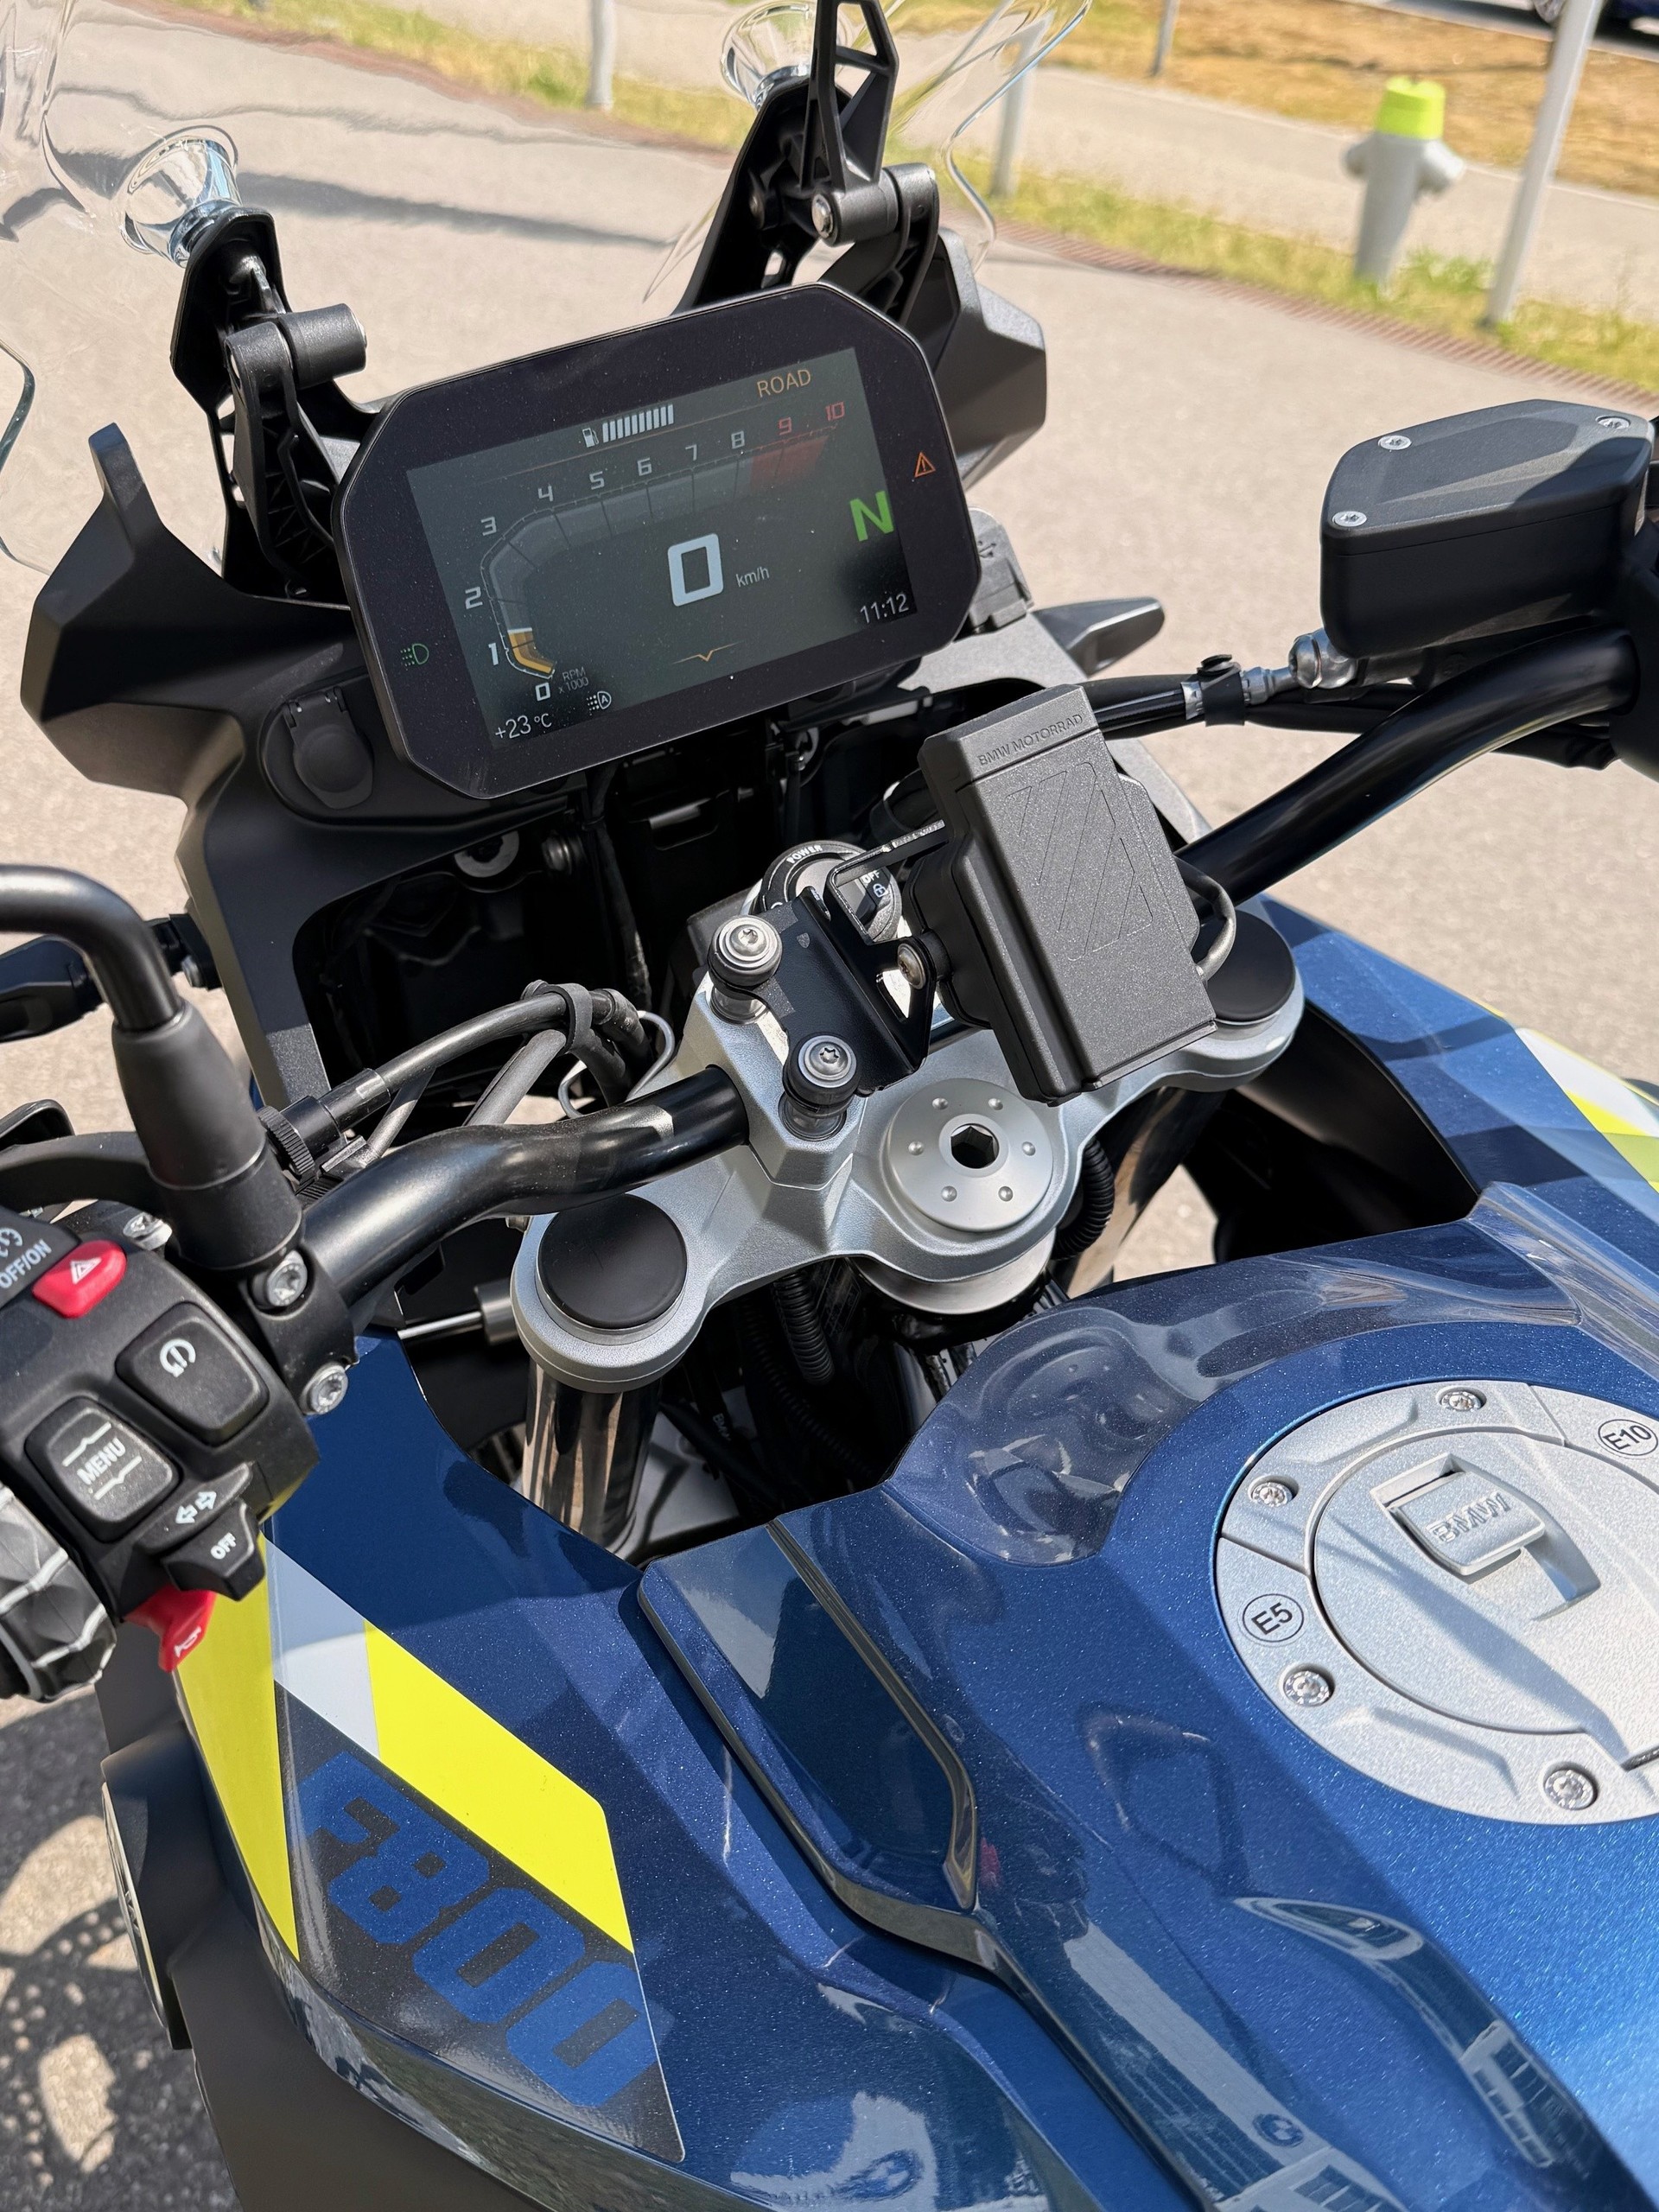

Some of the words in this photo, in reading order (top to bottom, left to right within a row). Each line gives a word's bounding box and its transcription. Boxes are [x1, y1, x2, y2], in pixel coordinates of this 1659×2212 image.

[756, 369, 811, 397] ROAD
[825, 401, 846, 422] 10
[778, 417, 792, 435] 9
[731, 430, 746, 449] 8
[685, 444, 698, 461] 7
[637, 458, 652, 476] 6
[589, 471, 605, 490] 5
[537, 485, 554, 502] 4
[480, 516, 498, 537] 3
[849, 490, 894, 542] N
[667, 533, 724, 607] 0
[735, 566, 770, 588] km/h
[464, 586, 483, 610] 2
[860, 592, 910, 624] 11:12
[488, 642, 499, 666] 1
[562, 666, 587, 682] RPM
[565, 677, 589, 692] 1000
[535, 682, 551, 702] 0
[495, 715, 531, 739] +23
[976, 744, 1010, 766] BMW
[1012, 714, 1084, 753] MOTORRAD
[785, 844, 823, 864] POWER
[862, 869, 880, 884] OFF
[0, 1237, 52, 1289] OFF/ON
[1603, 1425, 1652, 1451] E10
[76, 1437, 126, 1485] MENU
[1425, 1491, 1512, 1543] BMW
[210, 1532, 237, 1560] OFF
[1250, 1602, 1294, 1636] E5
[296, 1751, 660, 2108] F800
